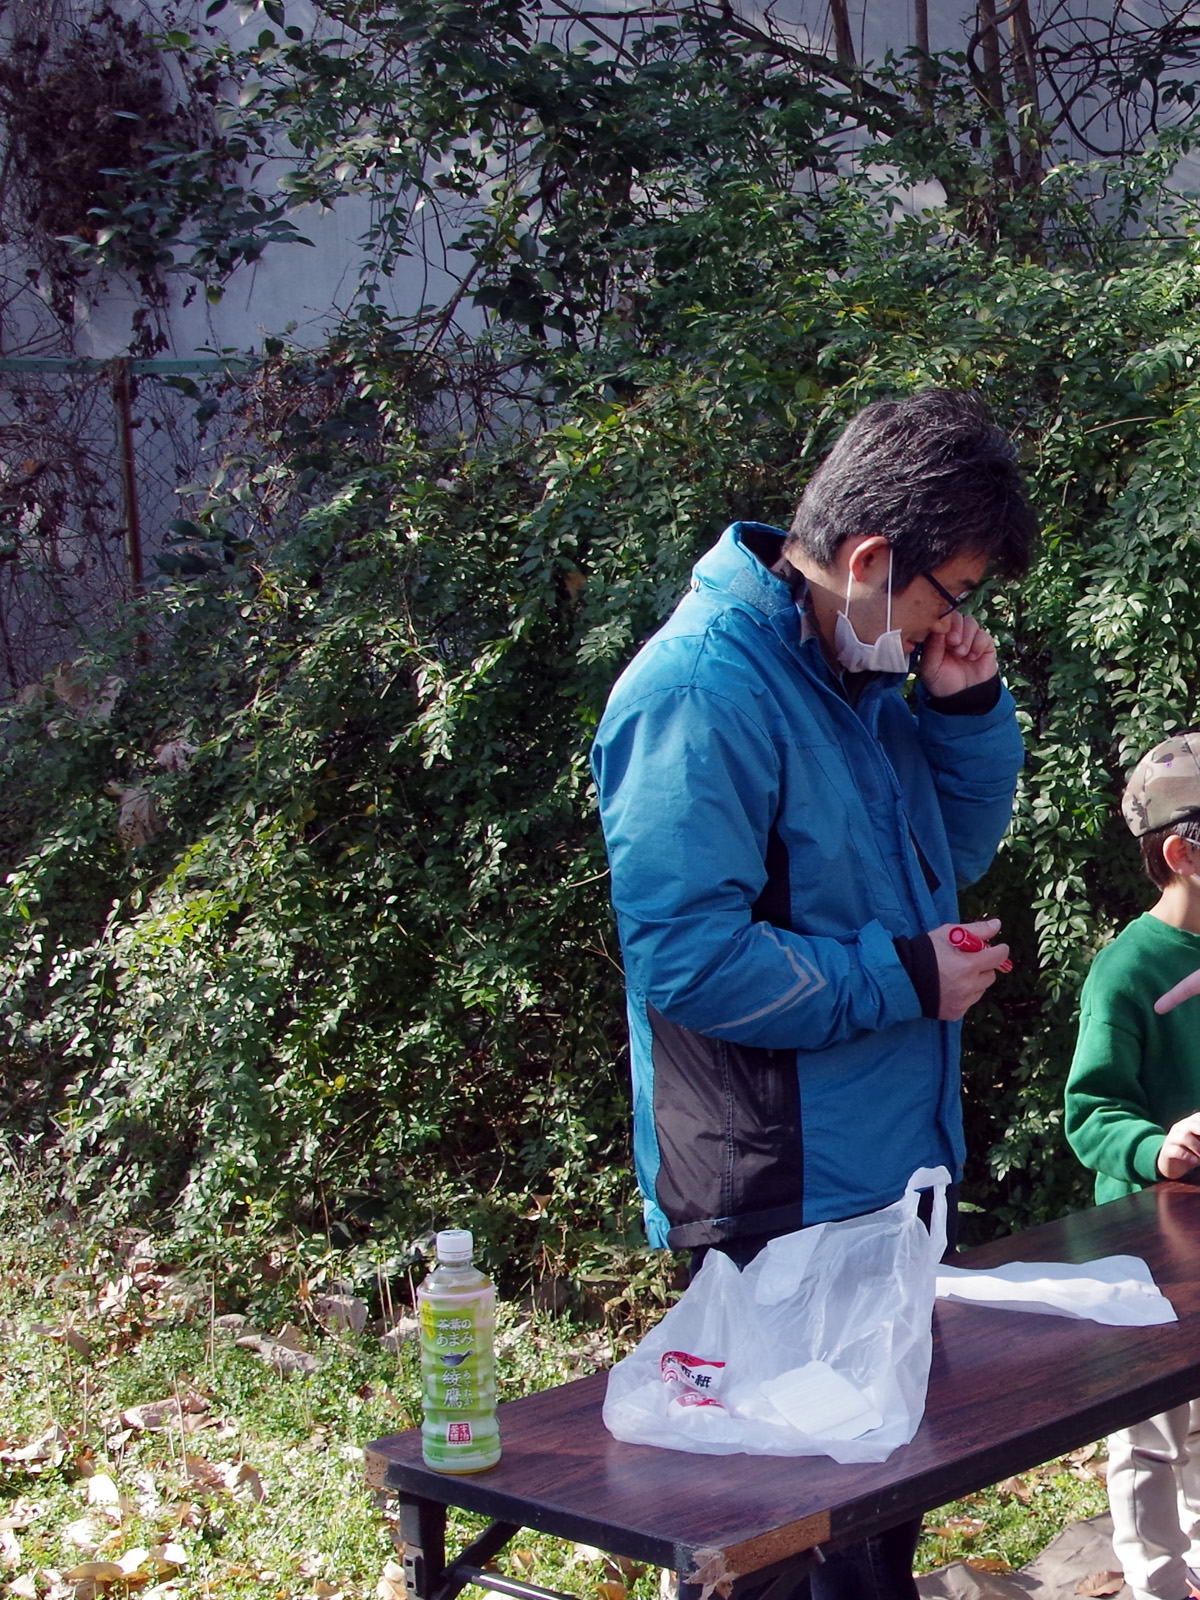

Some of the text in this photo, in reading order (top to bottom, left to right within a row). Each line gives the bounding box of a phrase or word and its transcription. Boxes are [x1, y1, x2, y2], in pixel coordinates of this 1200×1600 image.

[437, 1319, 471, 1332] 茶葉の
[436, 1331, 476, 1347] あまみ
[442, 1368, 463, 1408] 綾鷹
